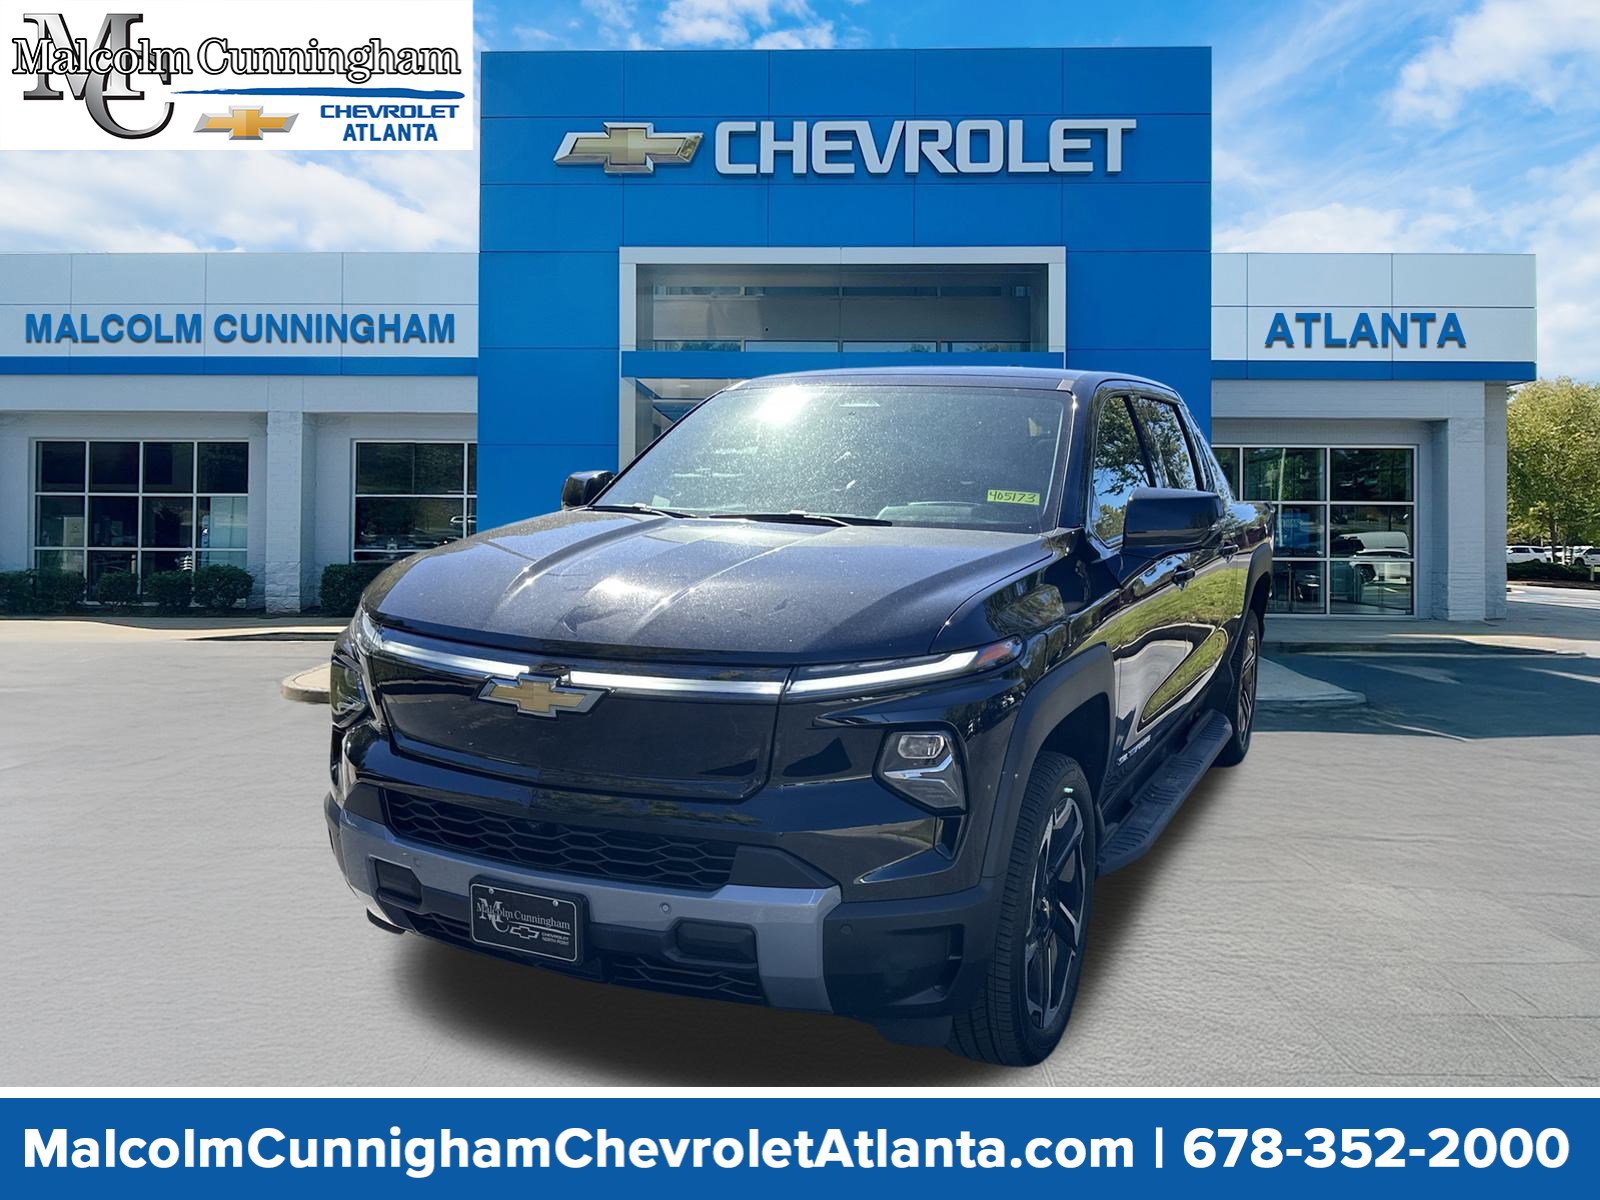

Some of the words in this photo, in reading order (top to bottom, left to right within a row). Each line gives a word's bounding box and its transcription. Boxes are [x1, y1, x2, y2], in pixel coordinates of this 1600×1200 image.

[714, 119, 1137, 175] CHEVROLET
[25, 313, 202, 344] MALCOLM
[213, 313, 455, 344] CUNNINGHAM
[1264, 312, 1467, 349] ATLANTA
[989, 491, 1035, 503] 405173
[476, 902, 514, 920] Malcolm
[514, 911, 570, 930] Cunningham
